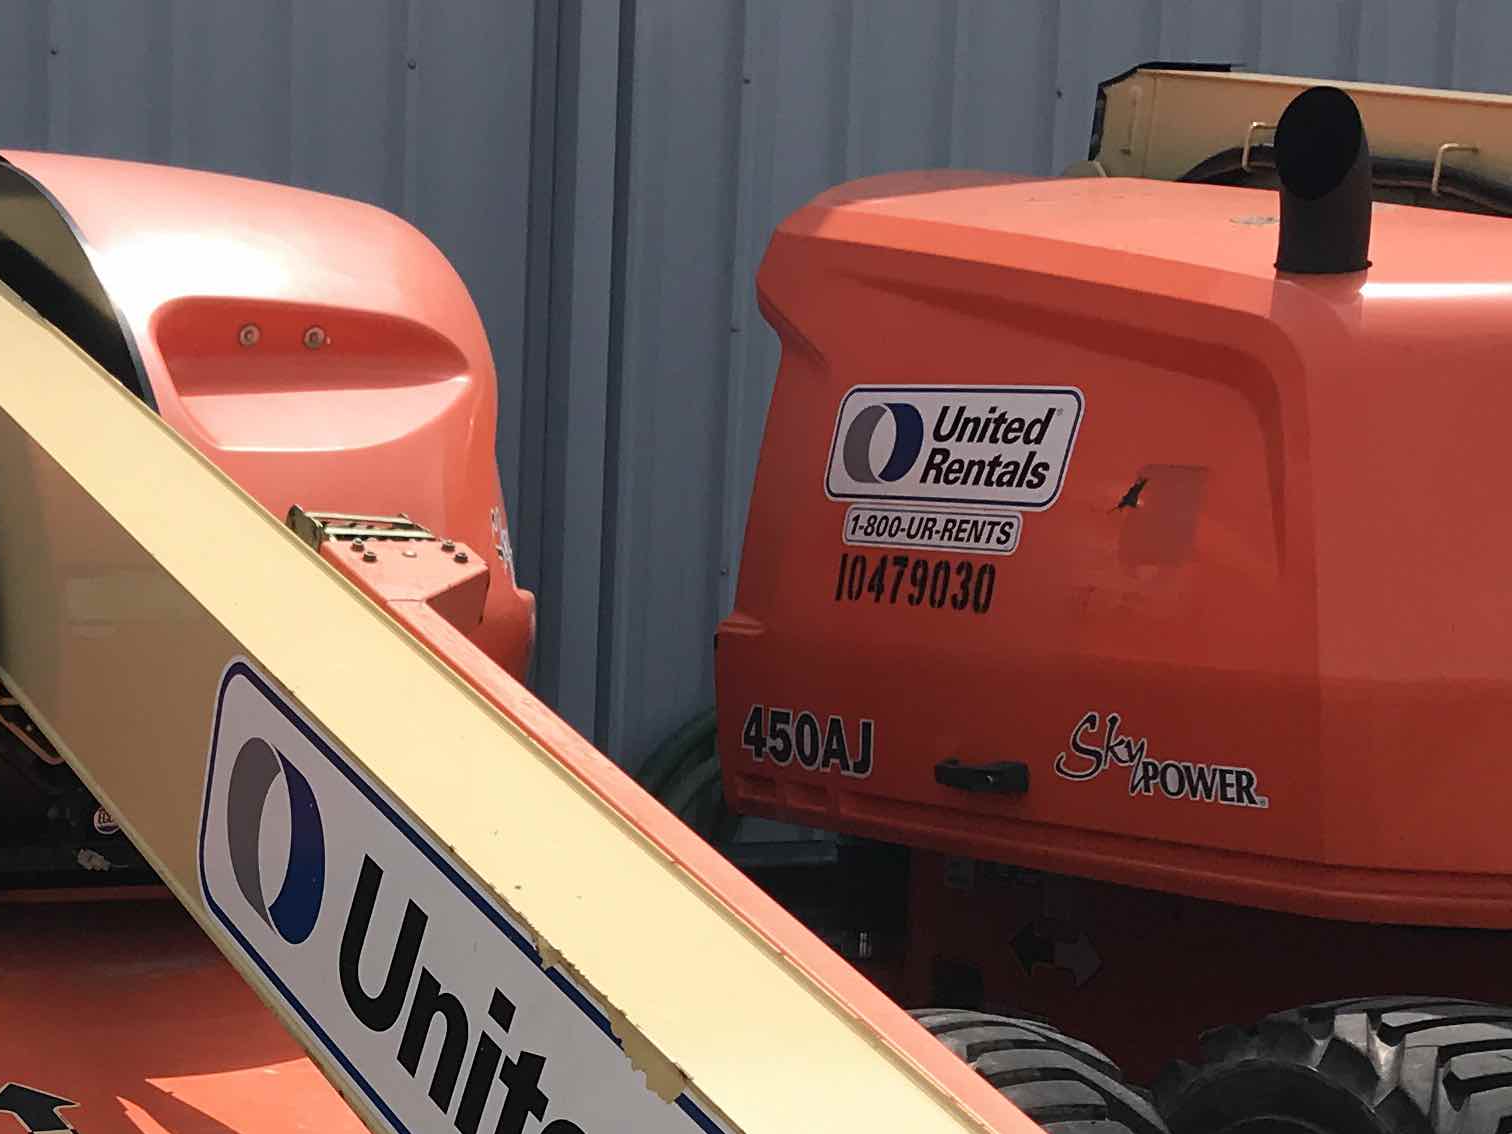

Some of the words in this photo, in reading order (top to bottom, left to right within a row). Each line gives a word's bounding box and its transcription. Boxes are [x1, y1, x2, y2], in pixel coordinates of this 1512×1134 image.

[932, 405, 1057, 445] United
[920, 448, 1050, 489] Rentals
[851, 514, 1014, 545] 1-800-UR-RENTS
[743, 705, 873, 777] 450AJ
[1055, 712, 1146, 795] Sky
[1141, 760, 1257, 805] POWER
